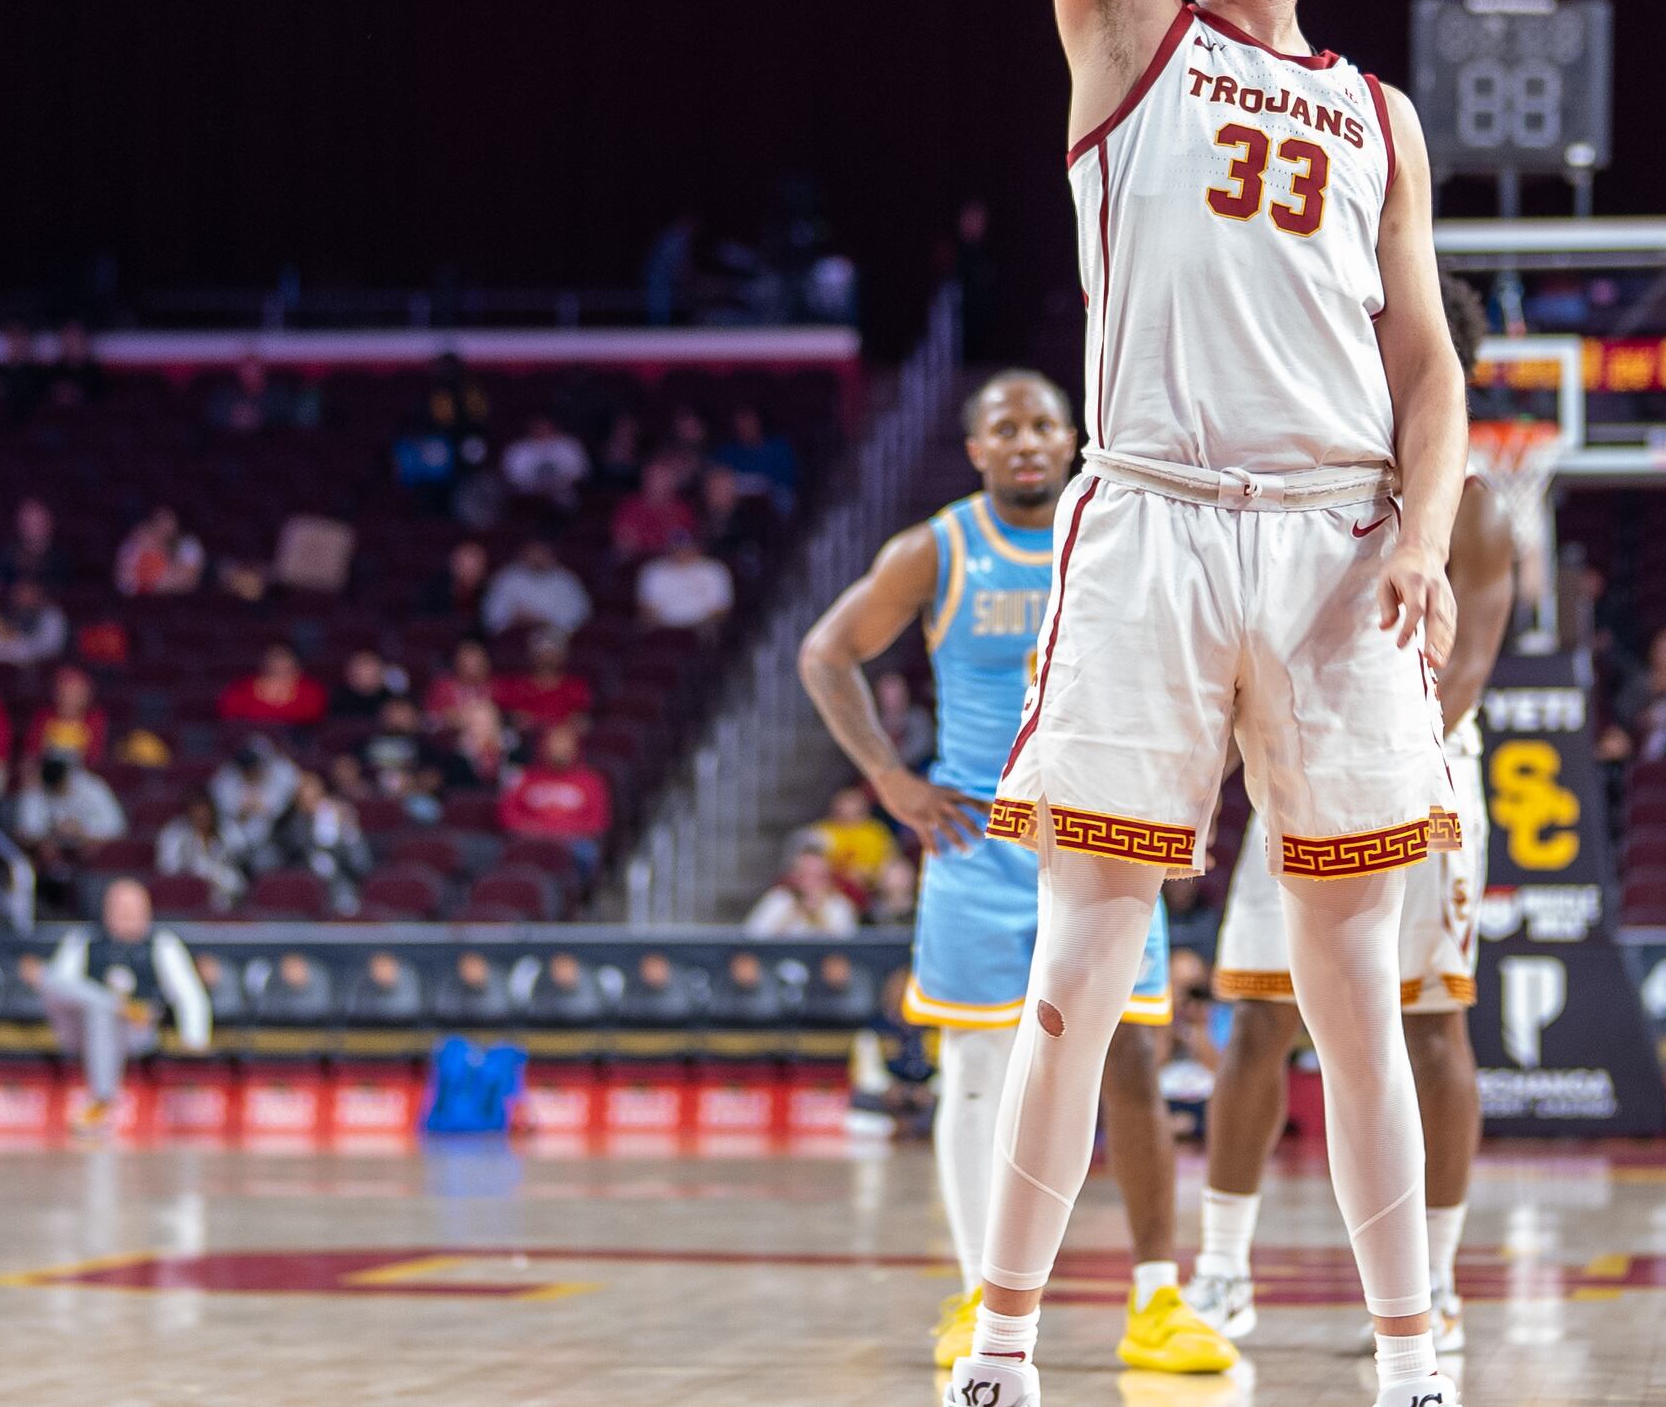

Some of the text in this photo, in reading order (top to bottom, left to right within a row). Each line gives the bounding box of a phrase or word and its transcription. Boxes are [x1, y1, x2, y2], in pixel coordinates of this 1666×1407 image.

[1186, 66, 1365, 150] TROJANS
[1204, 122, 1331, 239] 33
[972, 588, 1050, 636] SOUT
